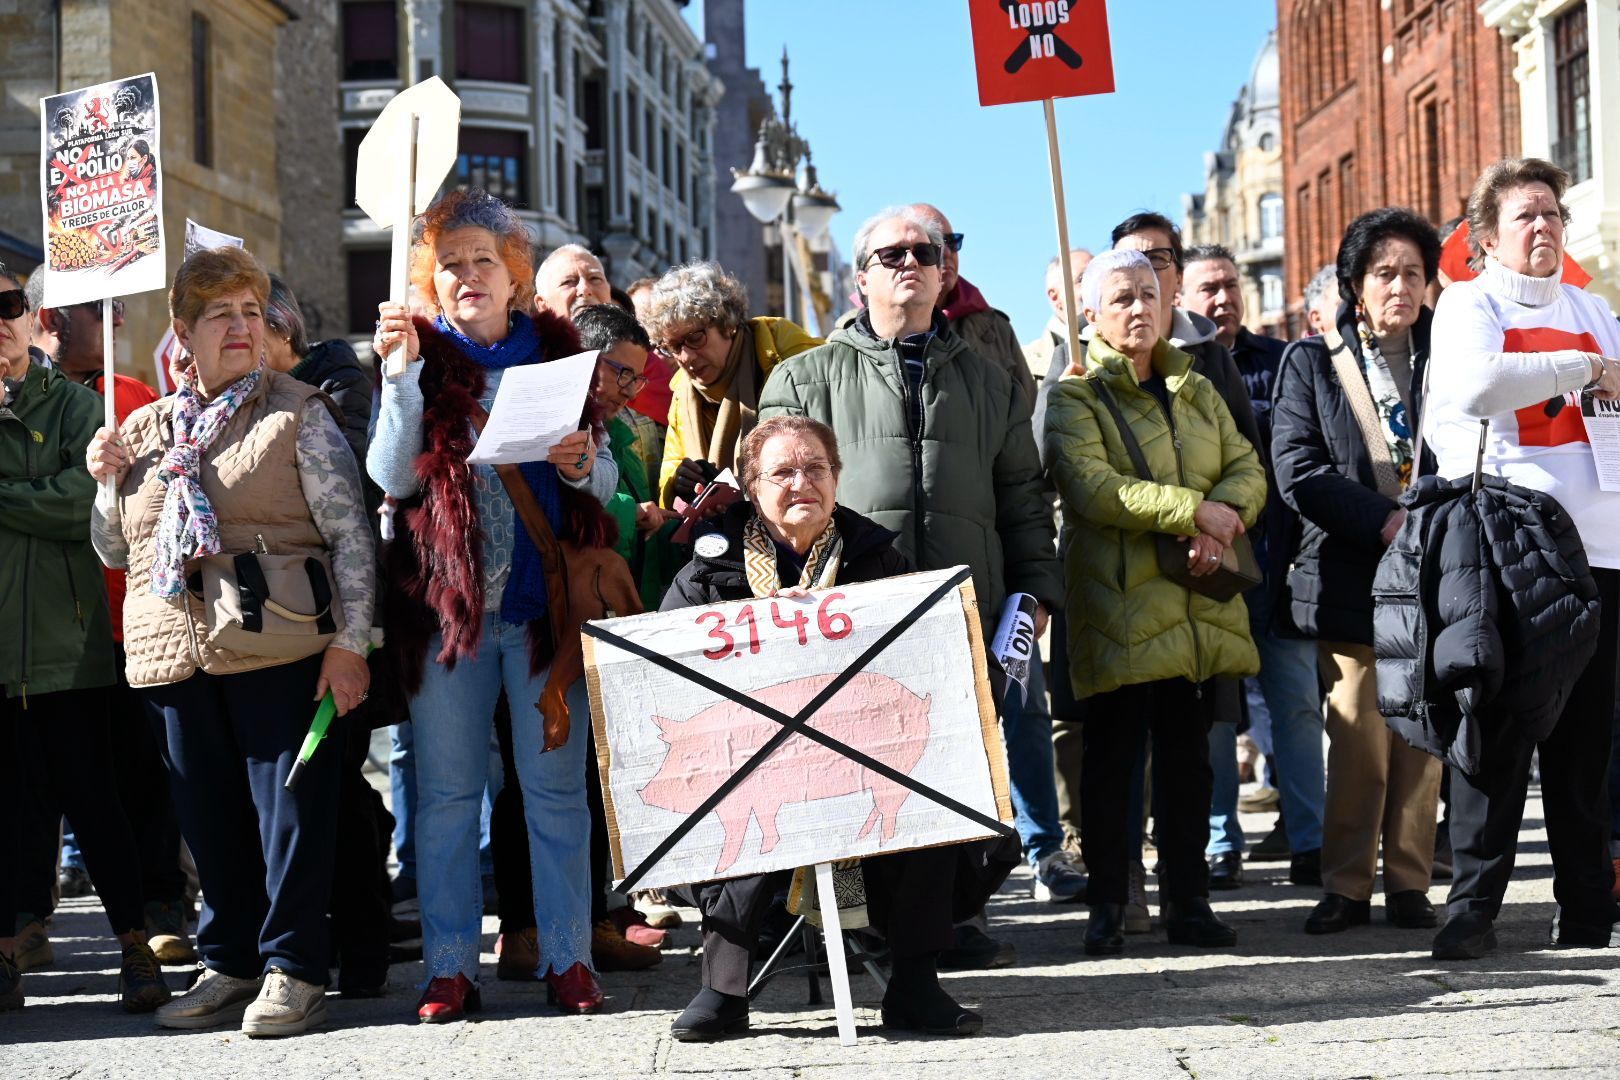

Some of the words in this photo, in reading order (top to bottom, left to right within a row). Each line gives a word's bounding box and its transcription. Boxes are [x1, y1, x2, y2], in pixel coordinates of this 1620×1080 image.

[1008, 0, 1070, 29] LODOS
[1029, 33, 1056, 59] NO
[67, 134, 104, 148] PLATAFORMA
[104, 130, 120, 140] LEÓN
[121, 128, 133, 137] SUR
[56, 147, 83, 165] NO
[88, 145, 104, 159] AL
[61, 180, 147, 218] BIOMASA
[66, 184, 88, 200] NO
[90, 180, 100, 191] A
[100, 176, 114, 188] LA
[62, 220, 67, 229] Y
[68, 213, 98, 228] REDES
[100, 211, 110, 220] DE
[112, 200, 144, 217] CALOR
[694, 592, 854, 661] 3.146
[1012, 620, 1033, 656] NO
